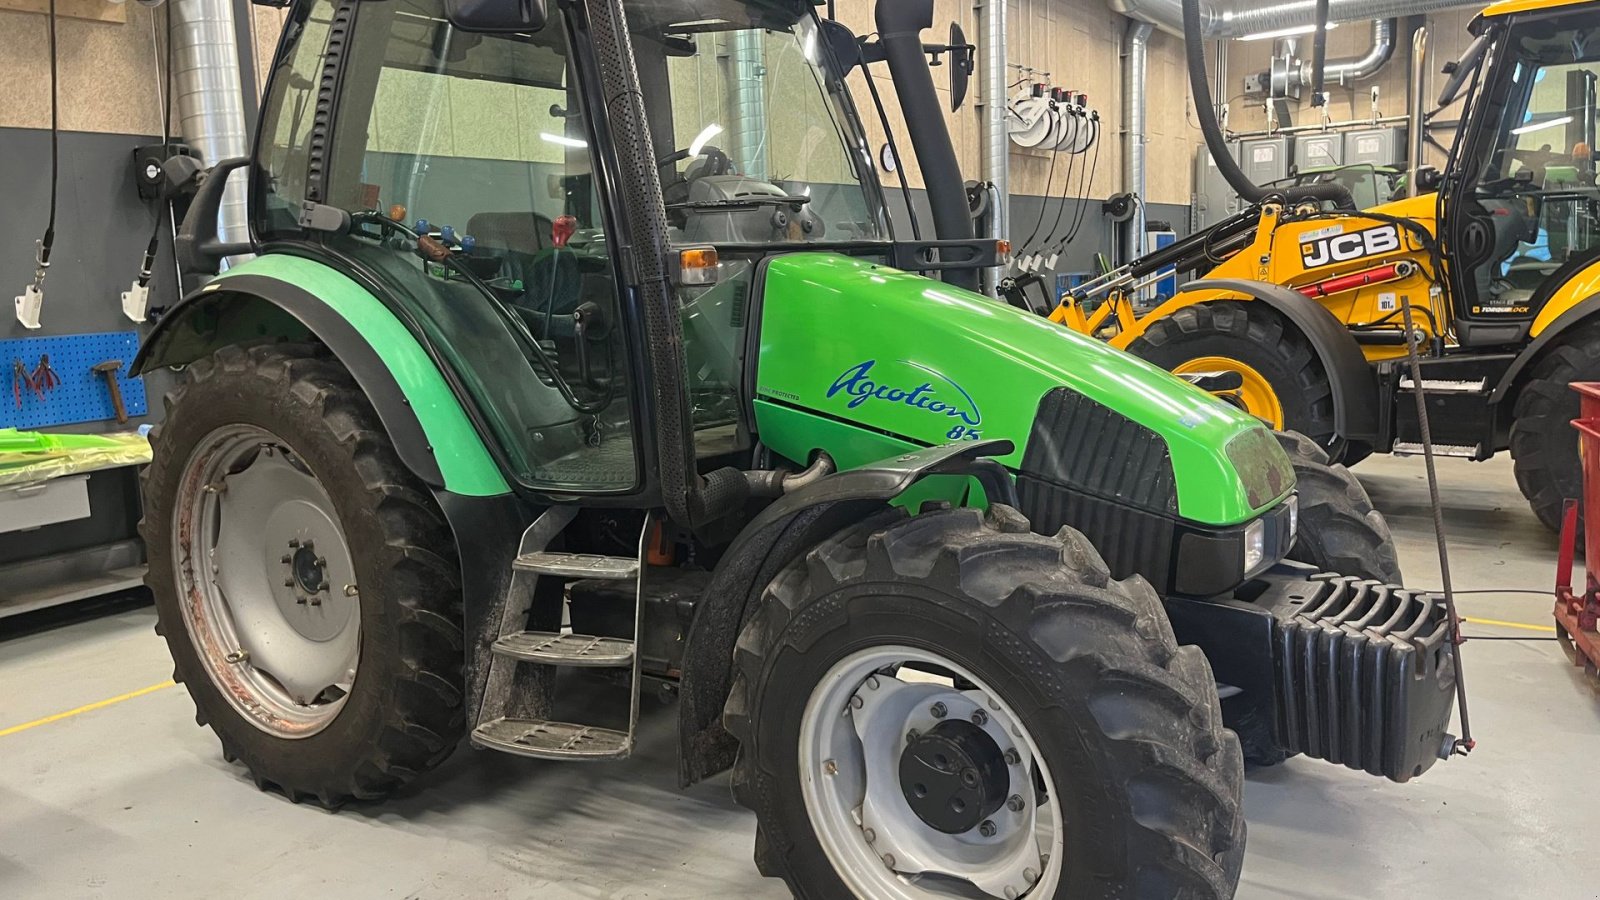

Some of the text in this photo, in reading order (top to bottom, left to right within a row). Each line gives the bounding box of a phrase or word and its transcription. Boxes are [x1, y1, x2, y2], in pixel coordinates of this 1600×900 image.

[1303, 225, 1399, 267] JCB
[771, 388, 800, 401] PROTECTED
[946, 425, 983, 441] 85
